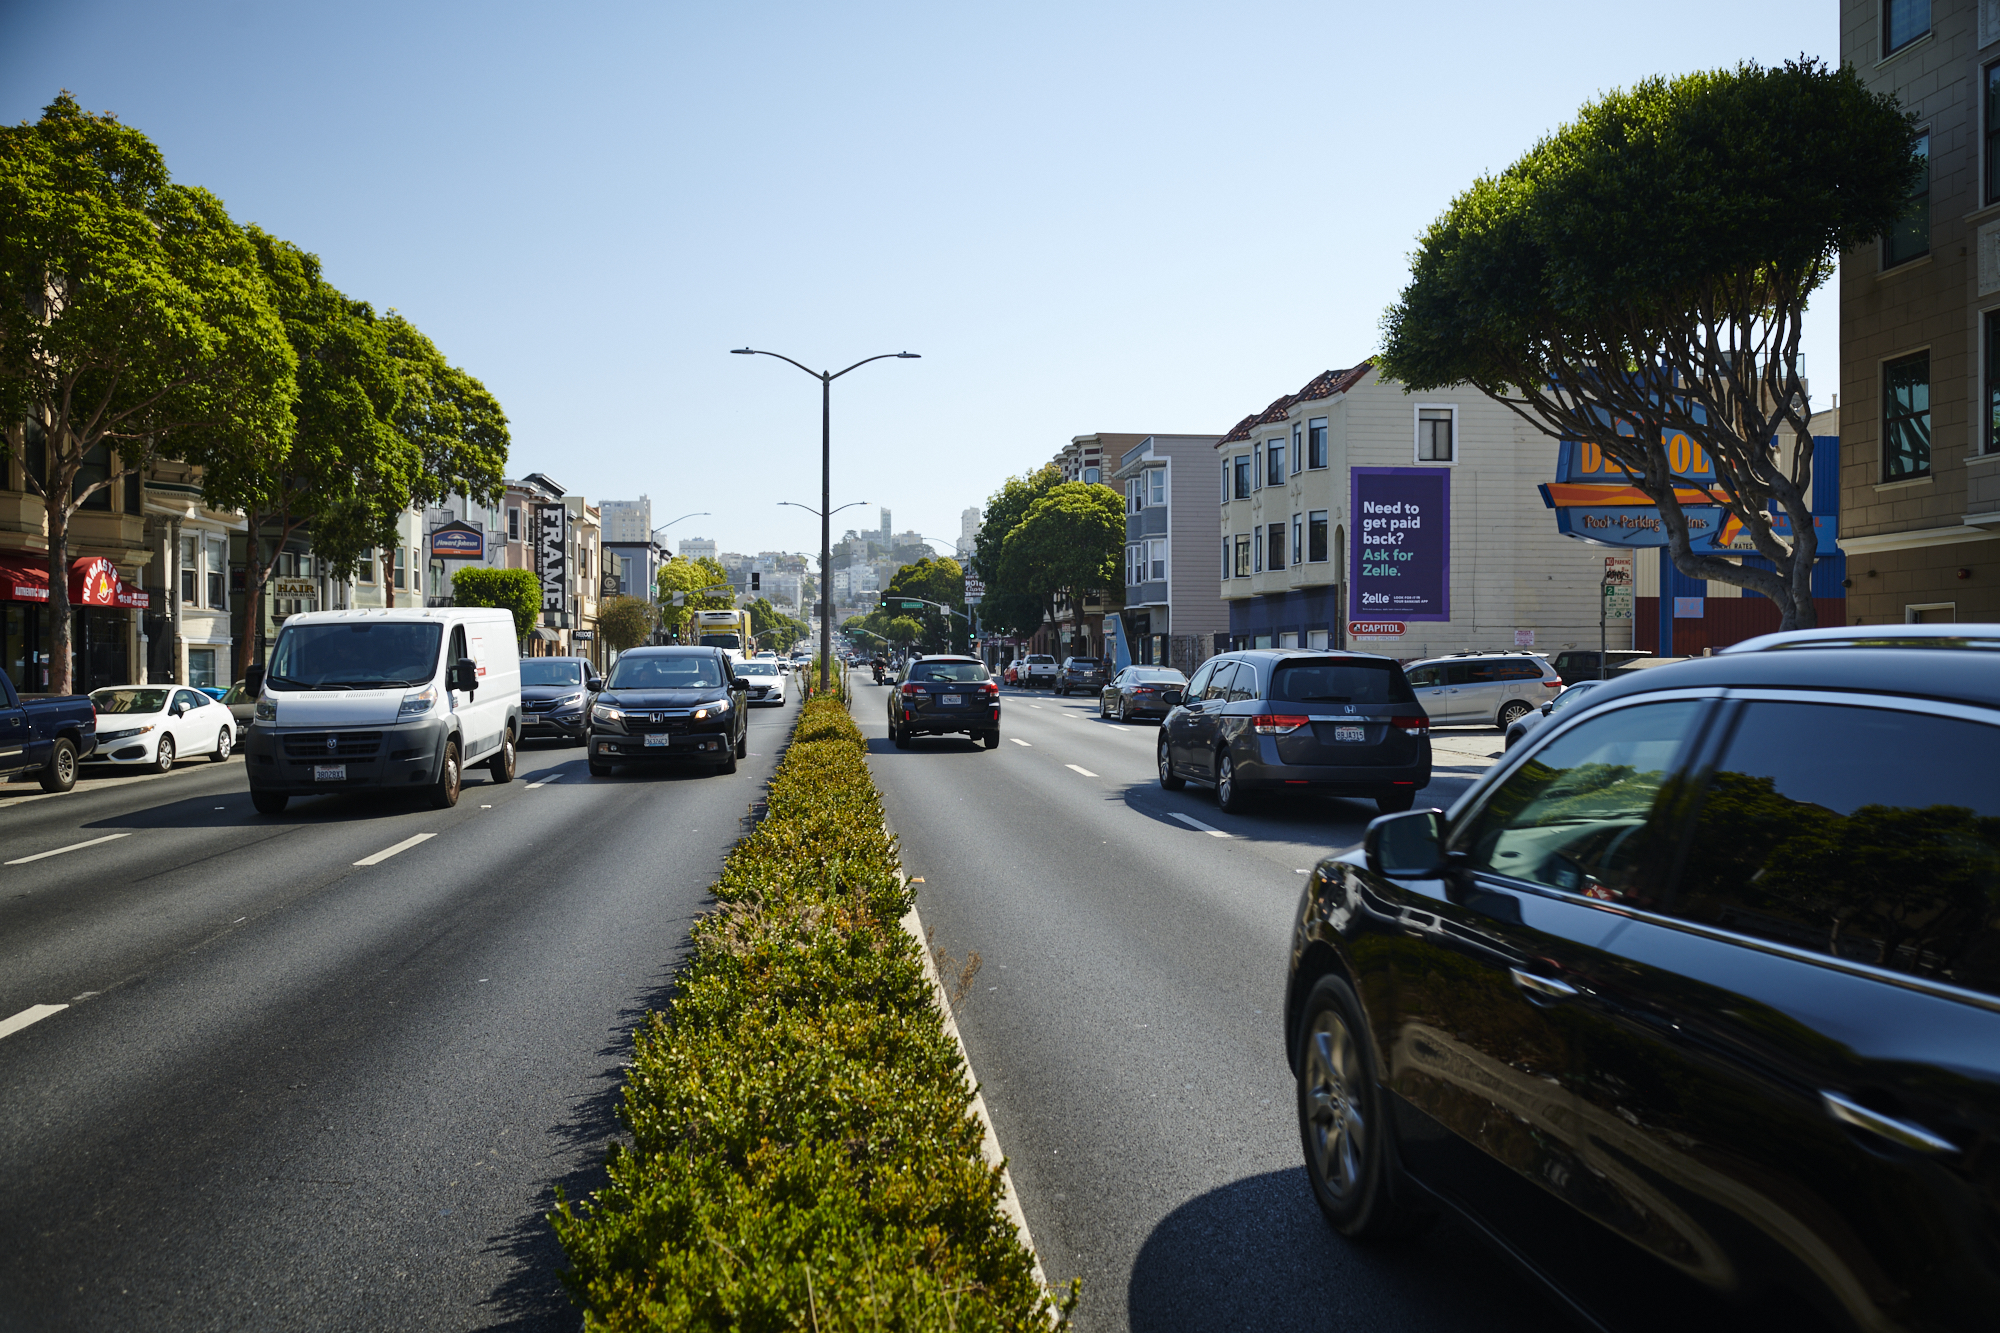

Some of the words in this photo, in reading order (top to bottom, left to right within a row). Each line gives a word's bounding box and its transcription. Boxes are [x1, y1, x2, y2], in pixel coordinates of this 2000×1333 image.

[1661, 434, 1709, 473] OL
[1363, 501, 1401, 514] Need
[1404, 503, 1420, 514] to
[1363, 518, 1387, 531] get
[1390, 516, 1420, 531] paid
[1585, 515, 1610, 528] Pool
[1620, 515, 1660, 532] Parking
[1363, 532, 1404, 544] back?
[543, 509, 562, 609] FRAME
[1363, 548, 1389, 561] Ask
[1393, 548, 1414, 561] for
[83, 559, 118, 602] NAMASTE
[277, 584, 315, 593] HAIR
[1608, 587, 1613, 595] 2
[1362, 624, 1400, 632] CAPITOL
